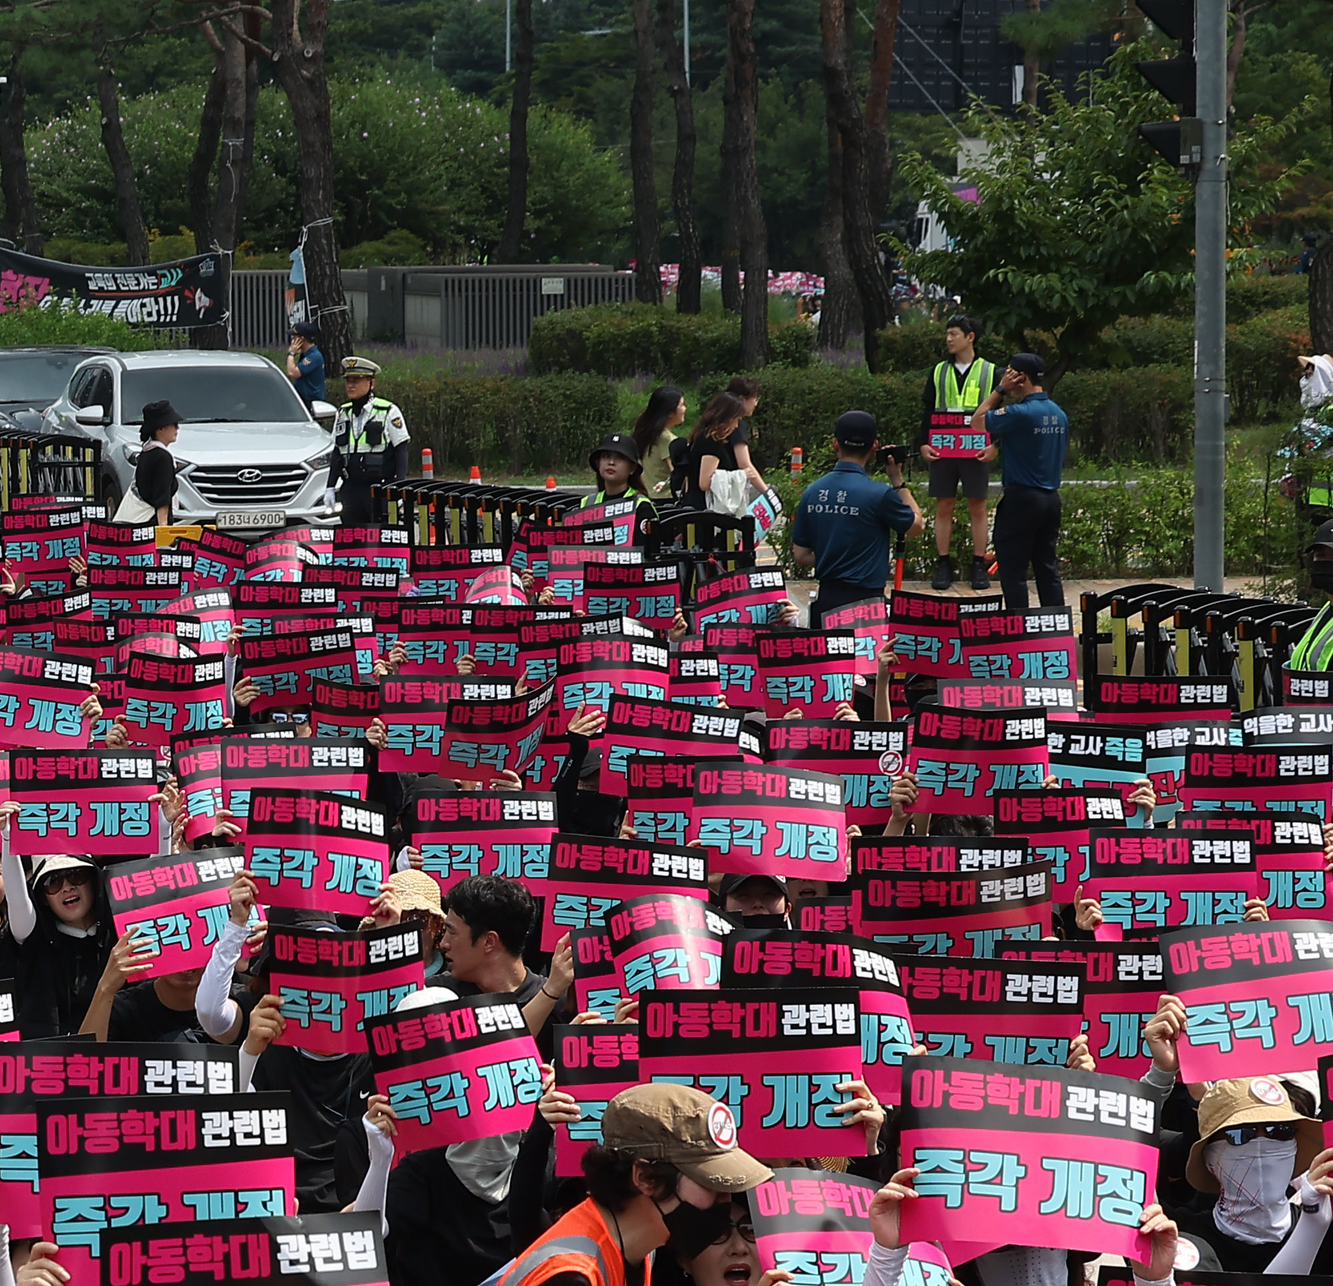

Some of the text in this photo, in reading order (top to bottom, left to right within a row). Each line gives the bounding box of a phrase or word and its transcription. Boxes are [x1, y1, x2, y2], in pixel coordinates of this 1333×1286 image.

[931, 434, 986, 450] 즉각 개정
[1034, 427, 1065, 435] POLICE
[818, 489, 848, 503] 경찰
[252, 513, 281, 524] 6900
[807, 504, 859, 516] POLICE
[961, 614, 1069, 636] 아동학대 관련법
[44, 660, 96, 687] 관련법
[25, 699, 81, 736] 개정
[15, 756, 152, 779] 아동학대 관련법
[18, 803, 149, 836] 즉각 개정
[1096, 837, 1250, 864] 아동학대 관련법
[1101, 892, 1246, 929] 즉각 개정
[911, 1069, 1154, 1133] 아동학대 관련법
[913, 1149, 1145, 1227] 즉각 개정
[110, 1230, 377, 1286] 아동학대 관련법
